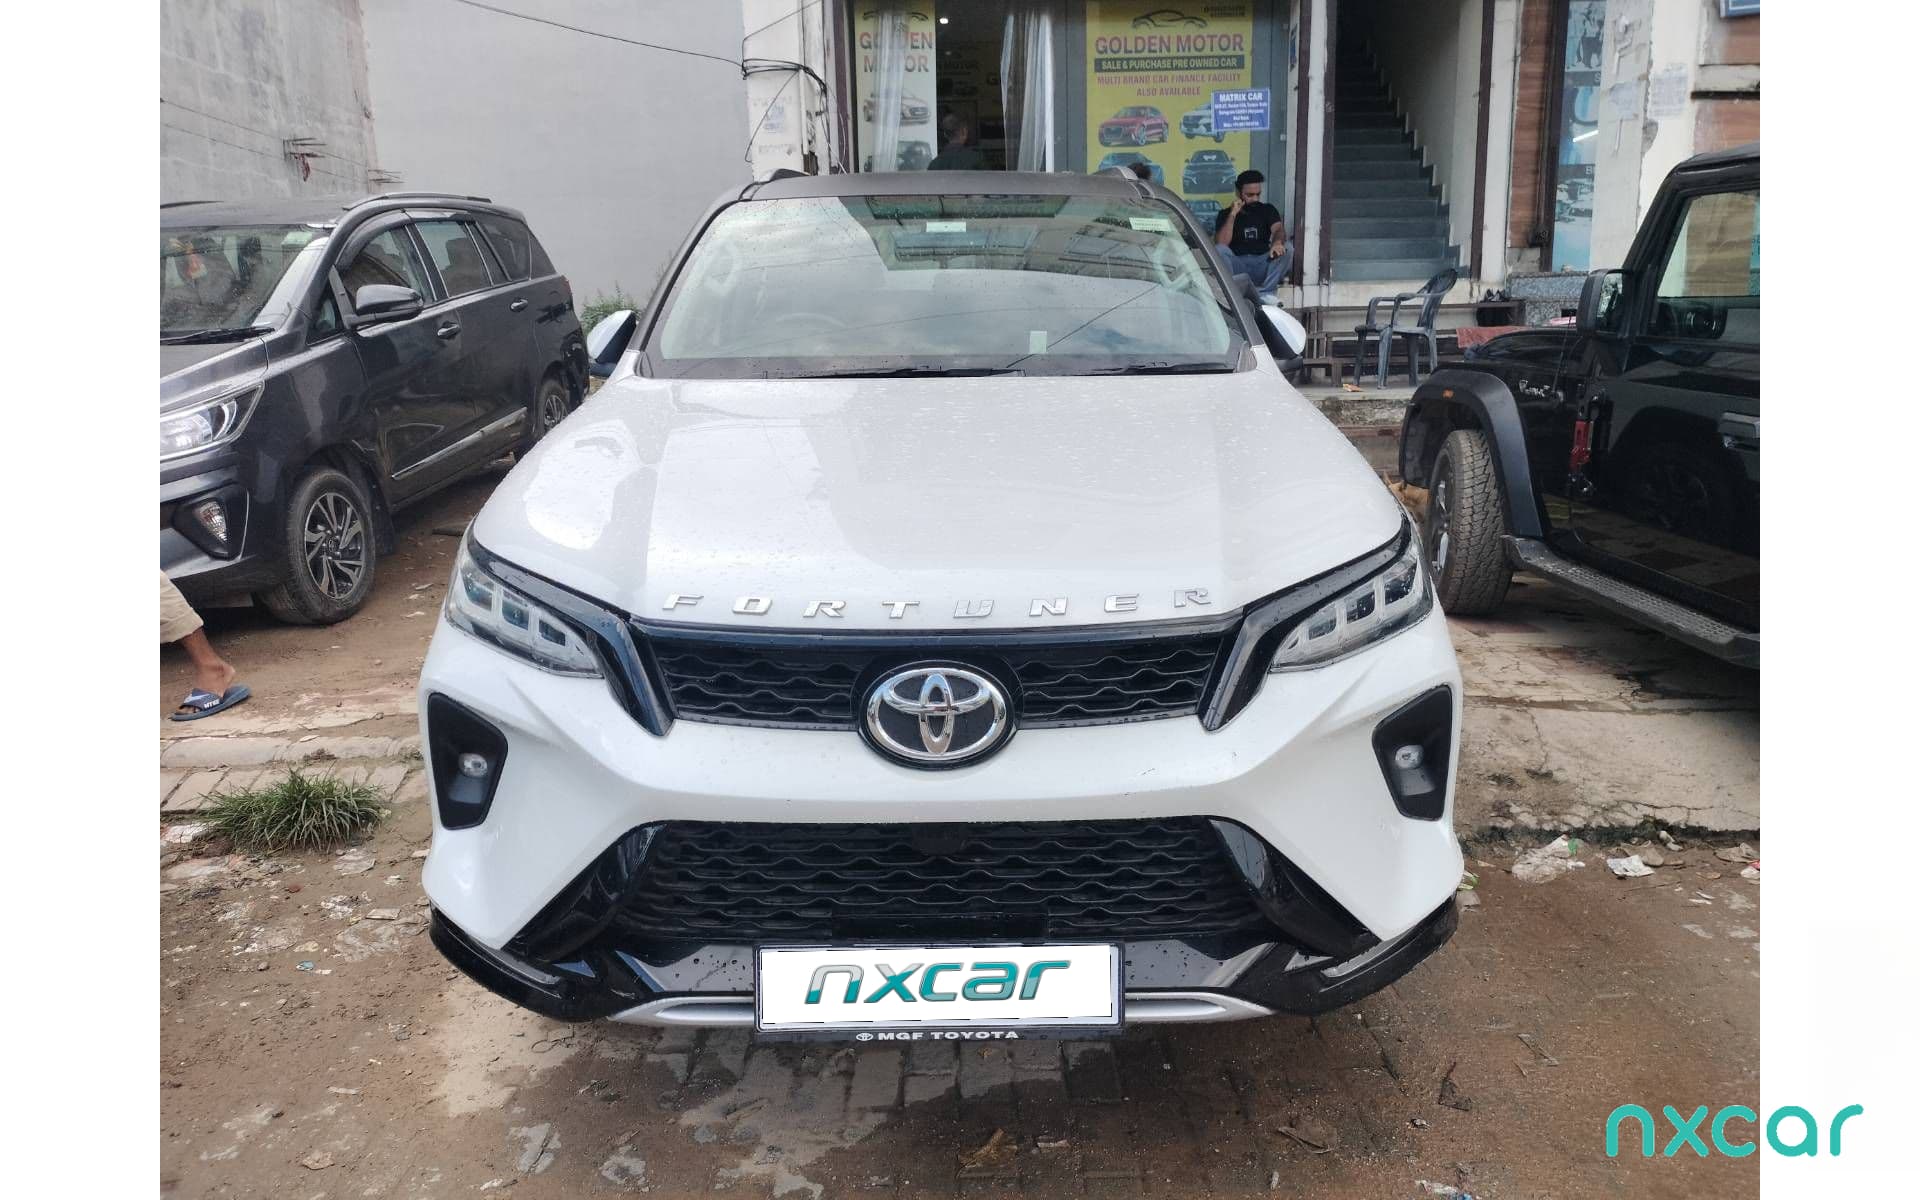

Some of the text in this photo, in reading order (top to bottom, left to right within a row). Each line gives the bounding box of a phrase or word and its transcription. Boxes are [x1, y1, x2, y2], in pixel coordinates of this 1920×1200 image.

[860, 32, 933, 49] GDEN
[1095, 33, 1244, 54] GOLDEN MOTOR
[863, 55, 929, 72] MOR
[1102, 59, 1122, 70] SALE
[1129, 58, 1172, 69] PURCHASE
[1173, 58, 1188, 68] PRE
[1189, 57, 1220, 68] OWNED
[1221, 57, 1237, 67] CAR
[1097, 75, 1121, 86] MULTI
[1171, 74, 1205, 83] FINANCE
[1208, 73, 1240, 83] FACILITY
[1136, 86, 1201, 97] ALSO AVAILABLE
[1219, 92, 1263, 102] MATRIX CAR
[662, 588, 1211, 619] FORTUNER
[878, 1031, 1019, 1041] MGF TOYOTA
